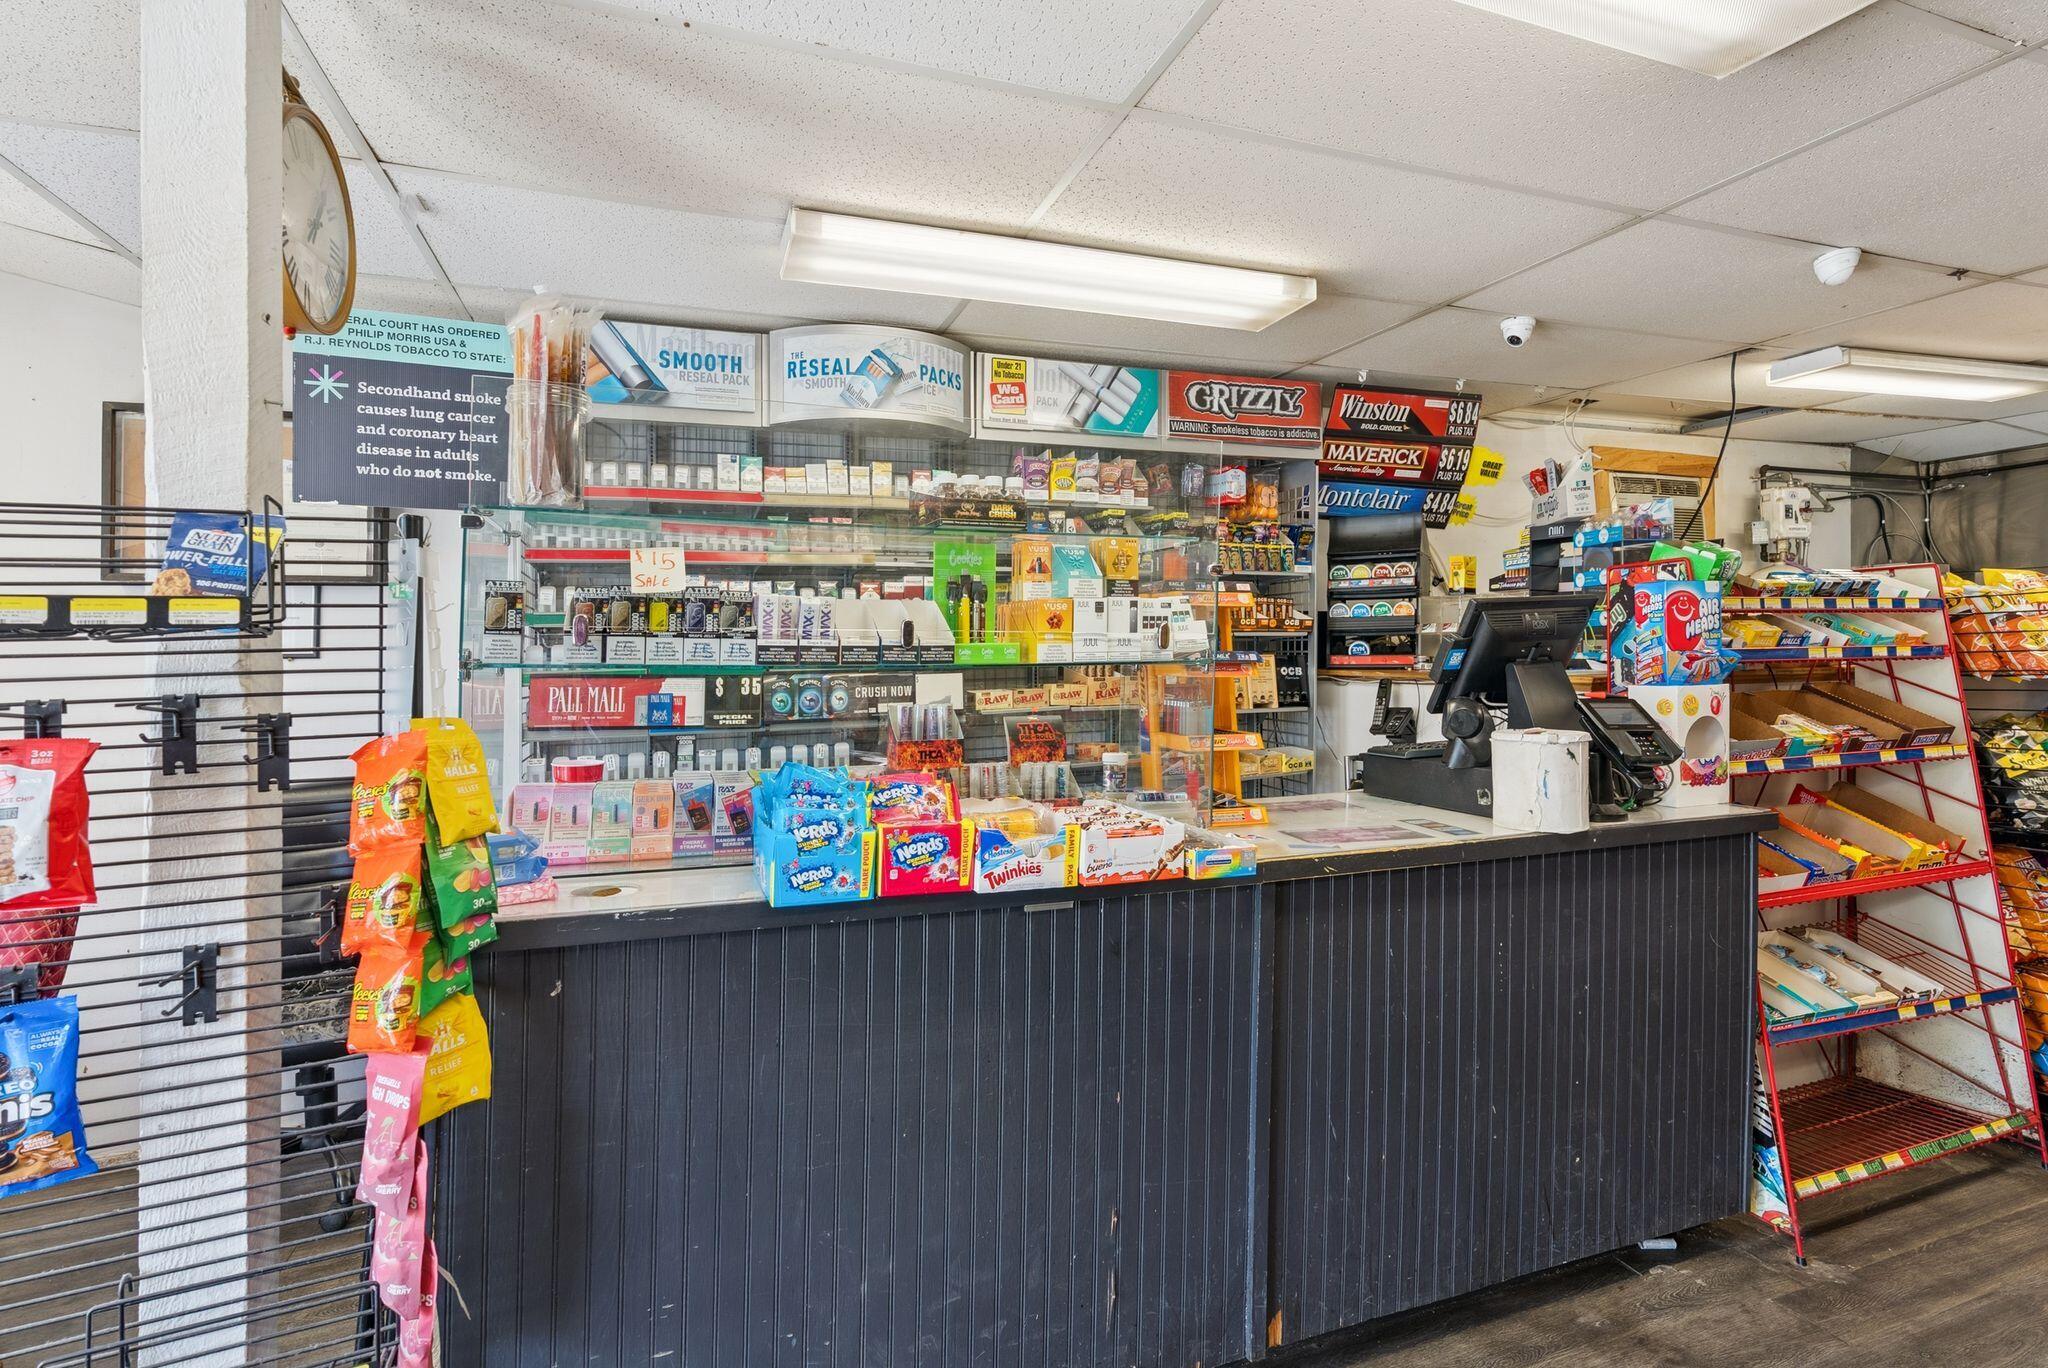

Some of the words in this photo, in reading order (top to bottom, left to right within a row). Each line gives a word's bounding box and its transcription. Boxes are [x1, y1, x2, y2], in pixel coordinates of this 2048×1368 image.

[380, 319, 417, 330] COURT
[421, 323, 445, 333] HAS
[448, 327, 500, 340] ORDERED
[348, 328, 383, 339] PHILIP
[387, 331, 430, 344] MORRIS
[434, 336, 456, 347] USA
[459, 339, 466, 348] &
[304, 336, 325, 345] R.J.
[329, 338, 390, 352] REYNOLDS
[395, 343, 448, 358] TOBACCO
[453, 350, 466, 360] TO
[470, 353, 506, 364] STATE:
[790, 351, 804, 360] THE
[659, 350, 743, 374] SMOOTH
[996, 360, 1012, 371] Under
[1015, 362, 1022, 371] 21
[680, 370, 719, 384] RESEAL
[722, 373, 750, 386] PACK
[787, 357, 852, 379] RESEAL
[920, 363, 961, 391] PACKS
[994, 369, 1001, 378] No
[1002, 371, 1024, 381] Tobacco
[805, 377, 846, 389] SMOOTH
[923, 384, 936, 397] ICE
[997, 384, 1020, 394] We
[358, 382, 451, 401] Secondhand
[455, 392, 501, 405] smoke
[845, 383, 870, 408] Marlboro
[991, 394, 1025, 406] Card
[1036, 396, 1058, 408] PACK
[1187, 380, 1306, 420] GRIZZLY
[357, 404, 407, 417] causes
[411, 407, 445, 422] lung
[448, 412, 496, 424] cancer
[1340, 394, 1410, 422] Winston
[1449, 400, 1479, 425] $6.84
[1170, 422, 1210, 434] WARNING:
[1212, 424, 1248, 438] Smokeless
[1250, 427, 1278, 438] tobacco
[1279, 428, 1286, 438] is
[1287, 428, 1320, 440] addictive.
[1379, 424, 1403, 432] CHOICE.
[1449, 426, 1463, 435] PLUS
[1463, 427, 1474, 436] TAX
[357, 425, 385, 436] and
[389, 427, 456, 443] coronary
[459, 431, 498, 444] heart
[357, 444, 412, 458] disease
[415, 446, 431, 459] in
[434, 449, 479, 462] adults
[1327, 445, 1422, 465] MAVERICK
[1439, 448, 1471, 471] $6.19
[1482, 460, 1503, 471] GREAT
[357, 464, 389, 477] who
[393, 466, 411, 478] do
[415, 468, 441, 479] not
[445, 469, 496, 483] smoke.
[1329, 465, 1361, 473] American
[1362, 467, 1385, 475] Quality
[1437, 471, 1451, 480] PLUS
[1451, 472, 1464, 481] TAX
[1480, 469, 1499, 479] VALUE
[1423, 491, 1458, 513] $4.84
[1455, 501, 1472, 511] Great
[1437, 514, 1448, 523] TAX
[1453, 508, 1469, 519] Price
[192, 531, 239, 543] NUTRI
[188, 538, 235, 552] GRAIN
[949, 550, 983, 566] Cookies
[211, 581, 246, 592] PROTEIN
[485, 580, 523, 589] AIRIS
[634, 575, 669, 587] SALE
[686, 587, 720, 595] AIRIS
[1650, 594, 1663, 604] AIR
[1642, 602, 1663, 615] HEADS
[1699, 598, 1720, 618] AIR
[1686, 613, 1720, 639] HEADS
[1781, 636, 1802, 645] HALLS
[1280, 667, 1302, 675] OCB
[715, 678, 723, 697] $
[740, 677, 761, 695] 35
[772, 681, 790, 689] CAMEL
[799, 678, 821, 687] CAMEL
[830, 680, 848, 688] CAMEL
[662, 694, 672, 702] MALL
[855, 686, 887, 698] CRUSH
[891, 686, 912, 697] NOW
[1060, 690, 1082, 700] RAW
[1095, 687, 1121, 699] RAW
[548, 686, 583, 713] PALL
[588, 686, 625, 713] MALL
[985, 694, 1009, 705] RAW
[1020, 693, 1044, 704] RAW
[1017, 723, 1053, 734] THCA
[1915, 735, 1938, 743] SNICKERS
[918, 751, 944, 759] THCA
[444, 765, 478, 777] HALLS
[456, 784, 480, 794] RELIEF
[1064, 805, 1096, 815] bueno
[1088, 814, 1121, 822] bueno
[1102, 818, 1136, 827] bueno
[985, 846, 1016, 860] Hostess
[1086, 860, 1113, 874] bueno
[983, 860, 1042, 889] Twinkies
[472, 899, 485, 909] 30
[429, 1056, 463, 1076] RELIEF
[384, 1091, 410, 1110] DROPS
